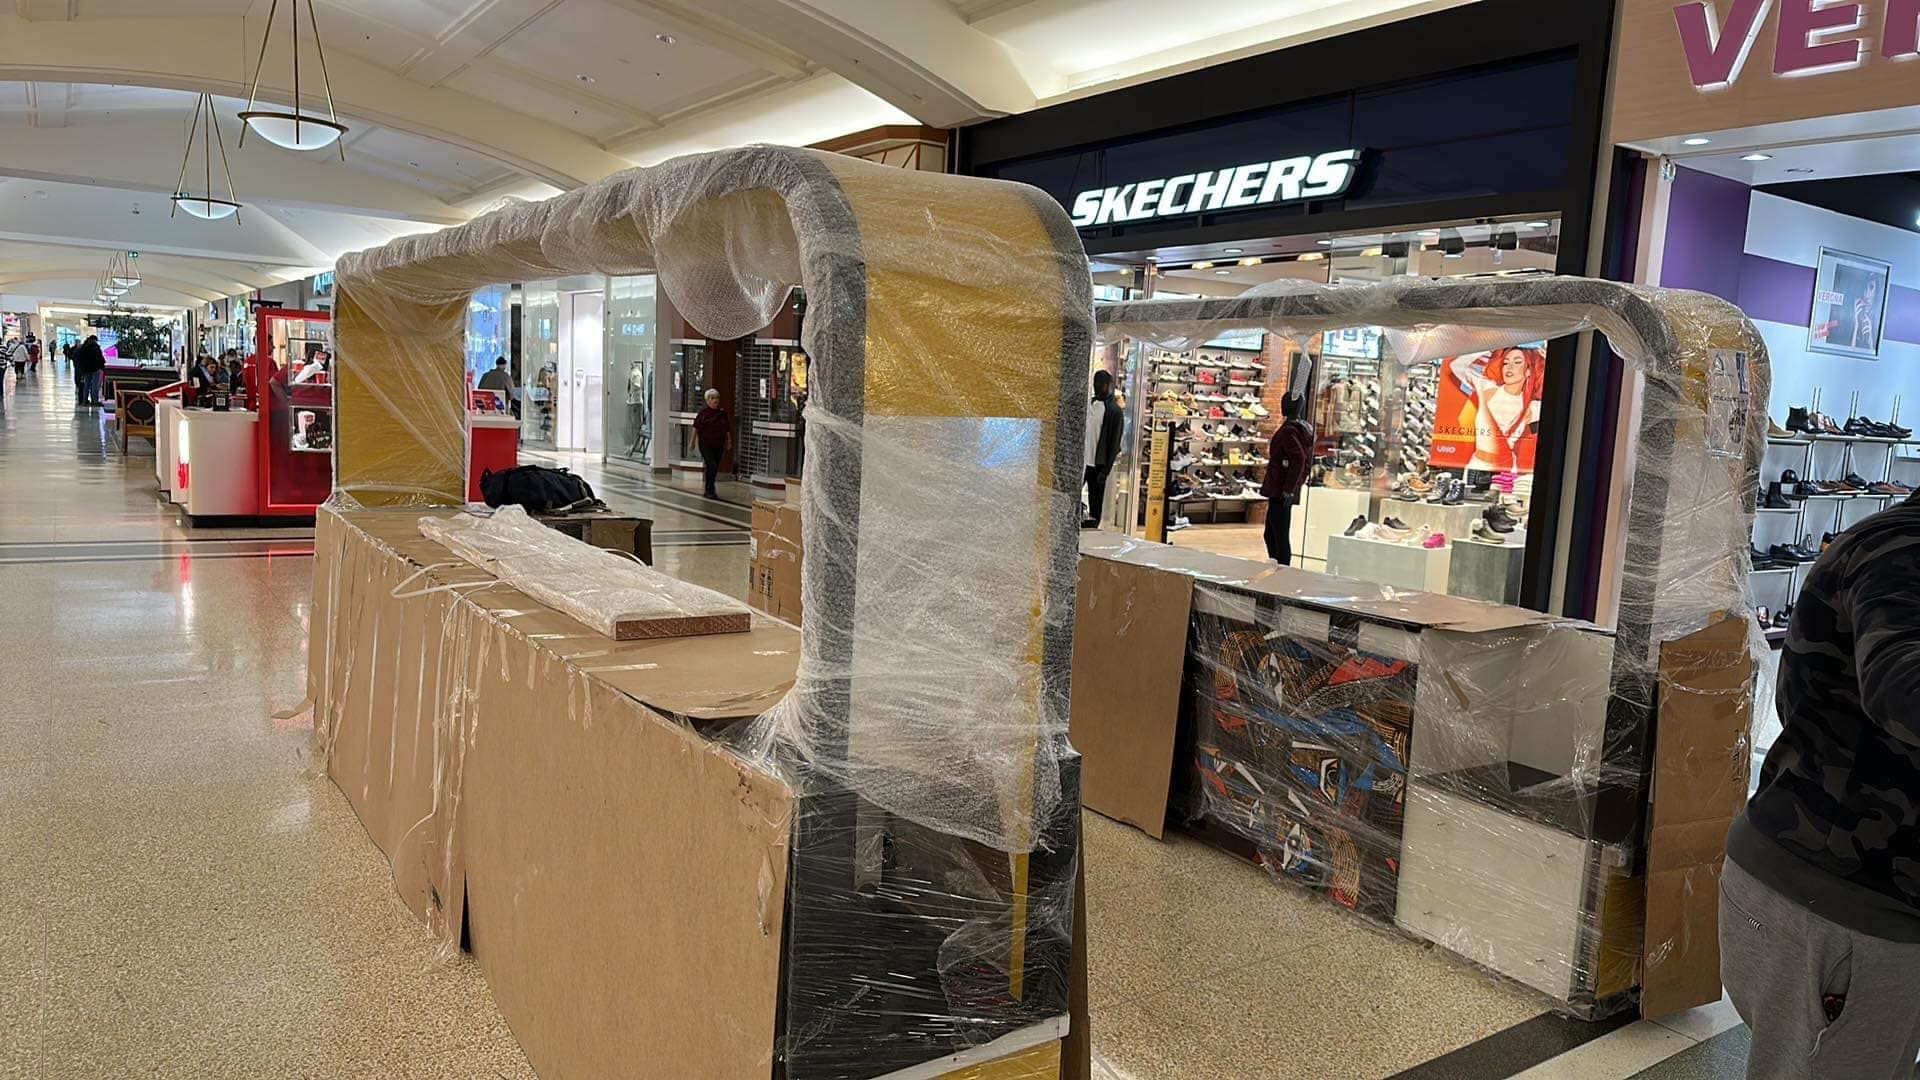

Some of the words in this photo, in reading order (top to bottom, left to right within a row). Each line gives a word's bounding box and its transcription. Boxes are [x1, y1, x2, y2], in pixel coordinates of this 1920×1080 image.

[1672, 0, 1920, 89] VE
[1071, 148, 1358, 228] SKECHERS
[1439, 425, 1491, 437] SKECHERS
